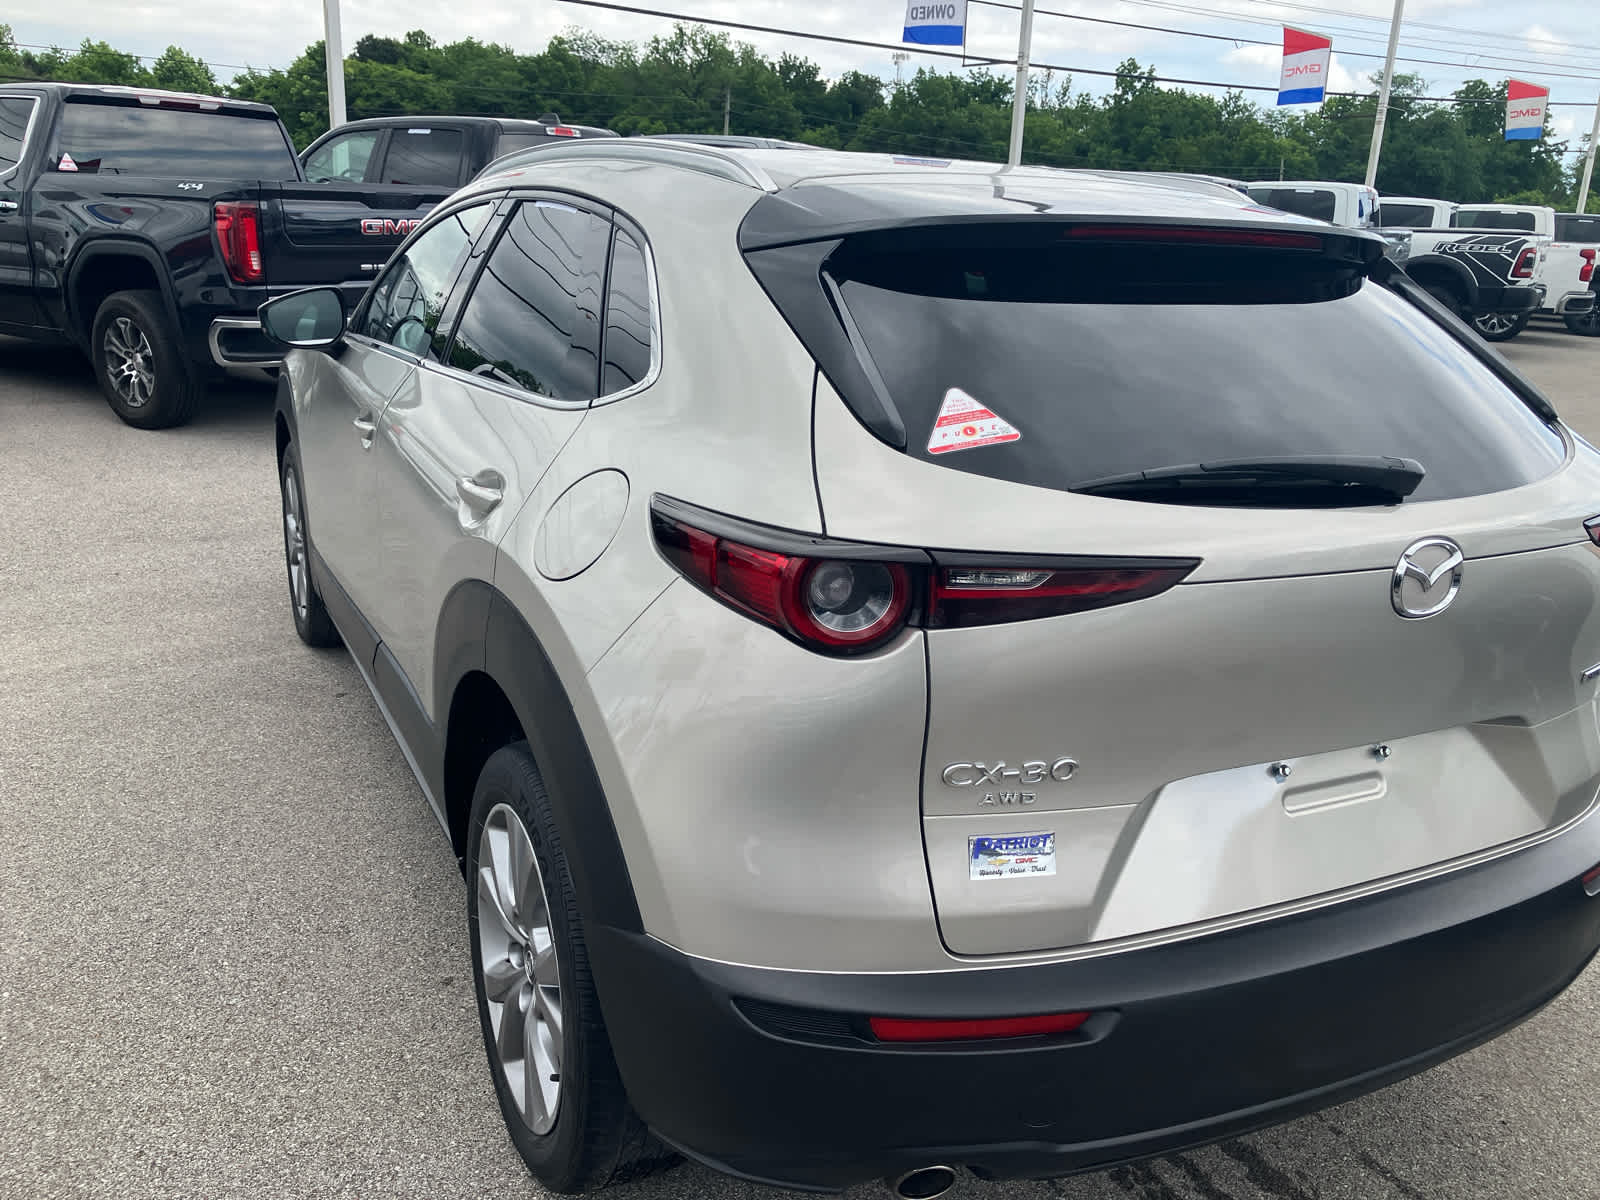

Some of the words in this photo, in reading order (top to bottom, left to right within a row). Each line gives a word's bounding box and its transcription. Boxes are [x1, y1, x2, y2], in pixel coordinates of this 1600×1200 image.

[1432, 240, 1512, 254] REBEL
[941, 758, 1079, 787] CX-30
[978, 791, 1037, 806] AWD
[973, 833, 1051, 860] PATRIOT
[1015, 856, 1038, 864] GMC
